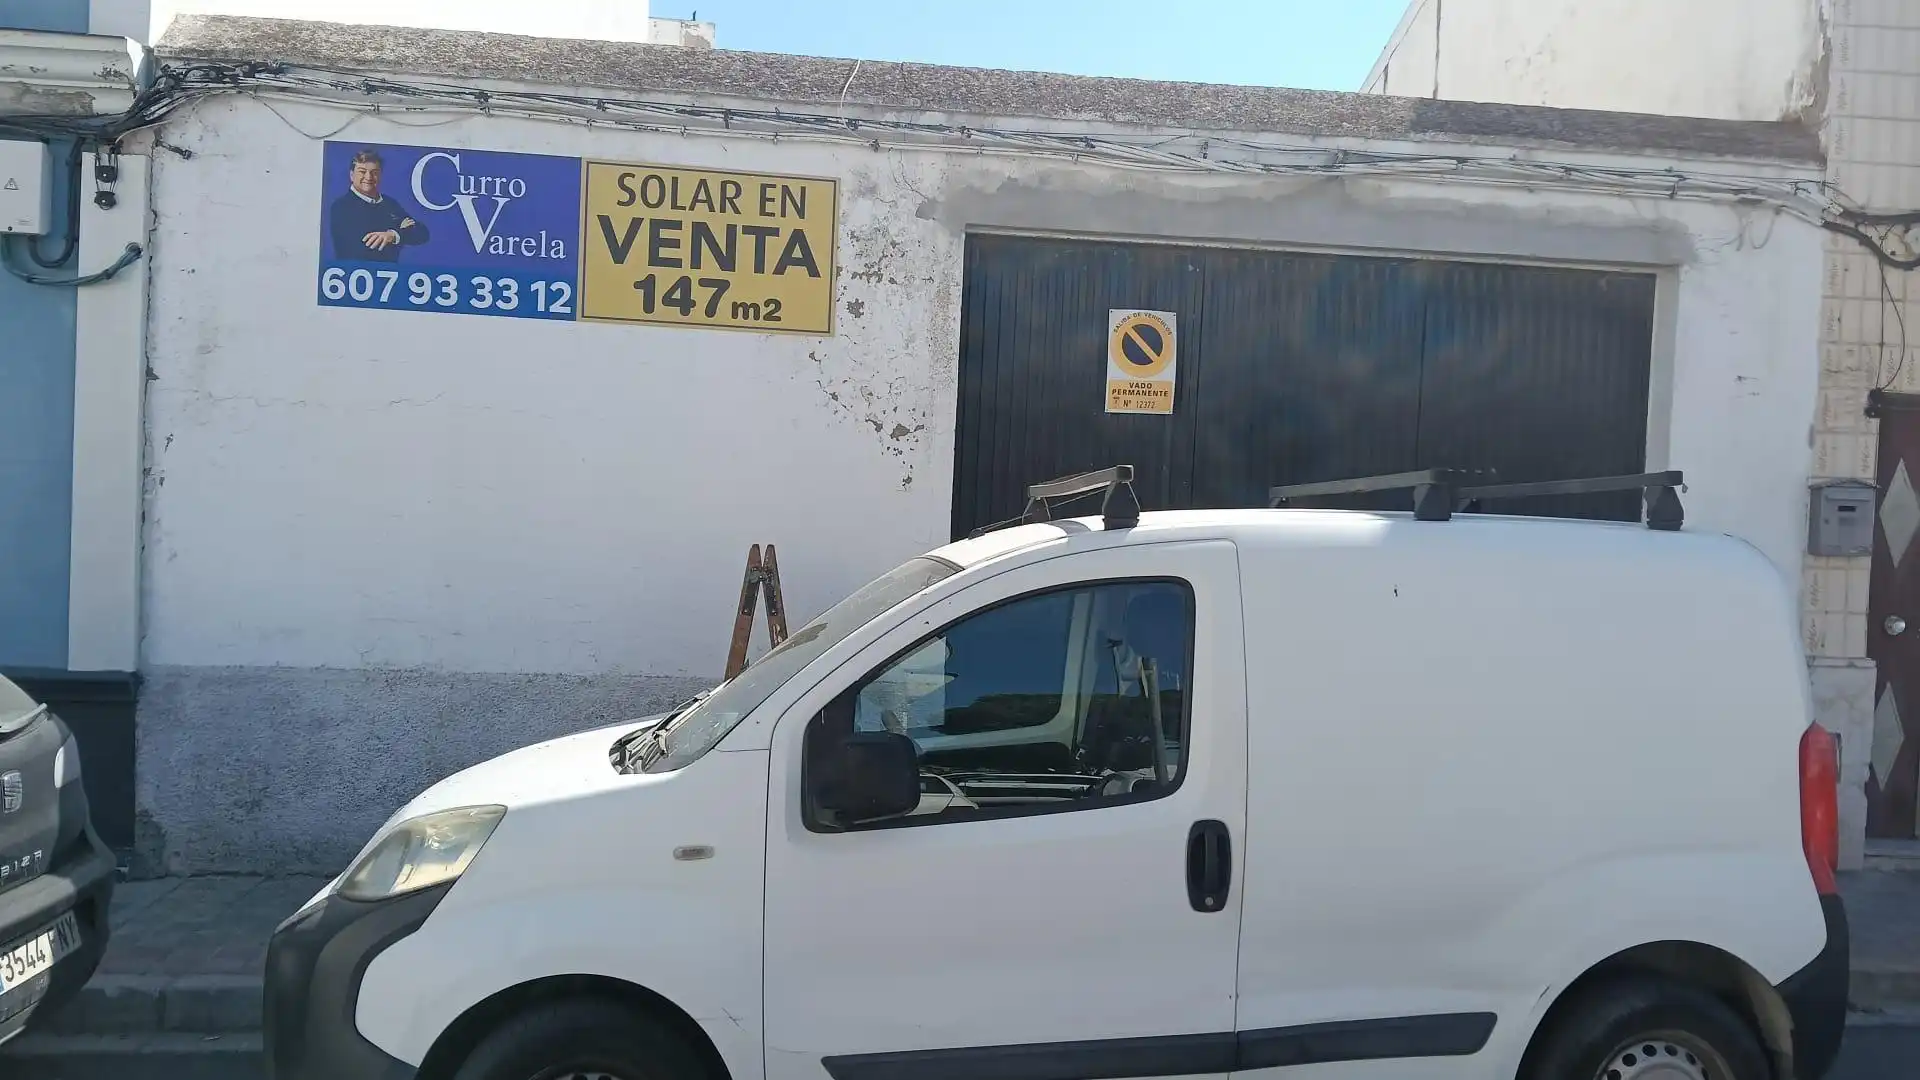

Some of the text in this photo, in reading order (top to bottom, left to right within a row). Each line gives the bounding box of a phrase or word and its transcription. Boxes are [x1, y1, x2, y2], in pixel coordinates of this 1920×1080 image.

[411, 152, 526, 211] Curro
[616, 172, 807, 219] SOLAR EN
[452, 194, 567, 260] Varela
[597, 214, 821, 279] VENTA
[322, 267, 572, 314] 607 93 33 12
[633, 273, 782, 322] 147 m2
[1113, 316, 1131, 334] SALIDA
[1112, 388, 1169, 398] PERMANENTE
[1129, 382, 1153, 390] VADO
[5, 934, 46, 983] 3544
